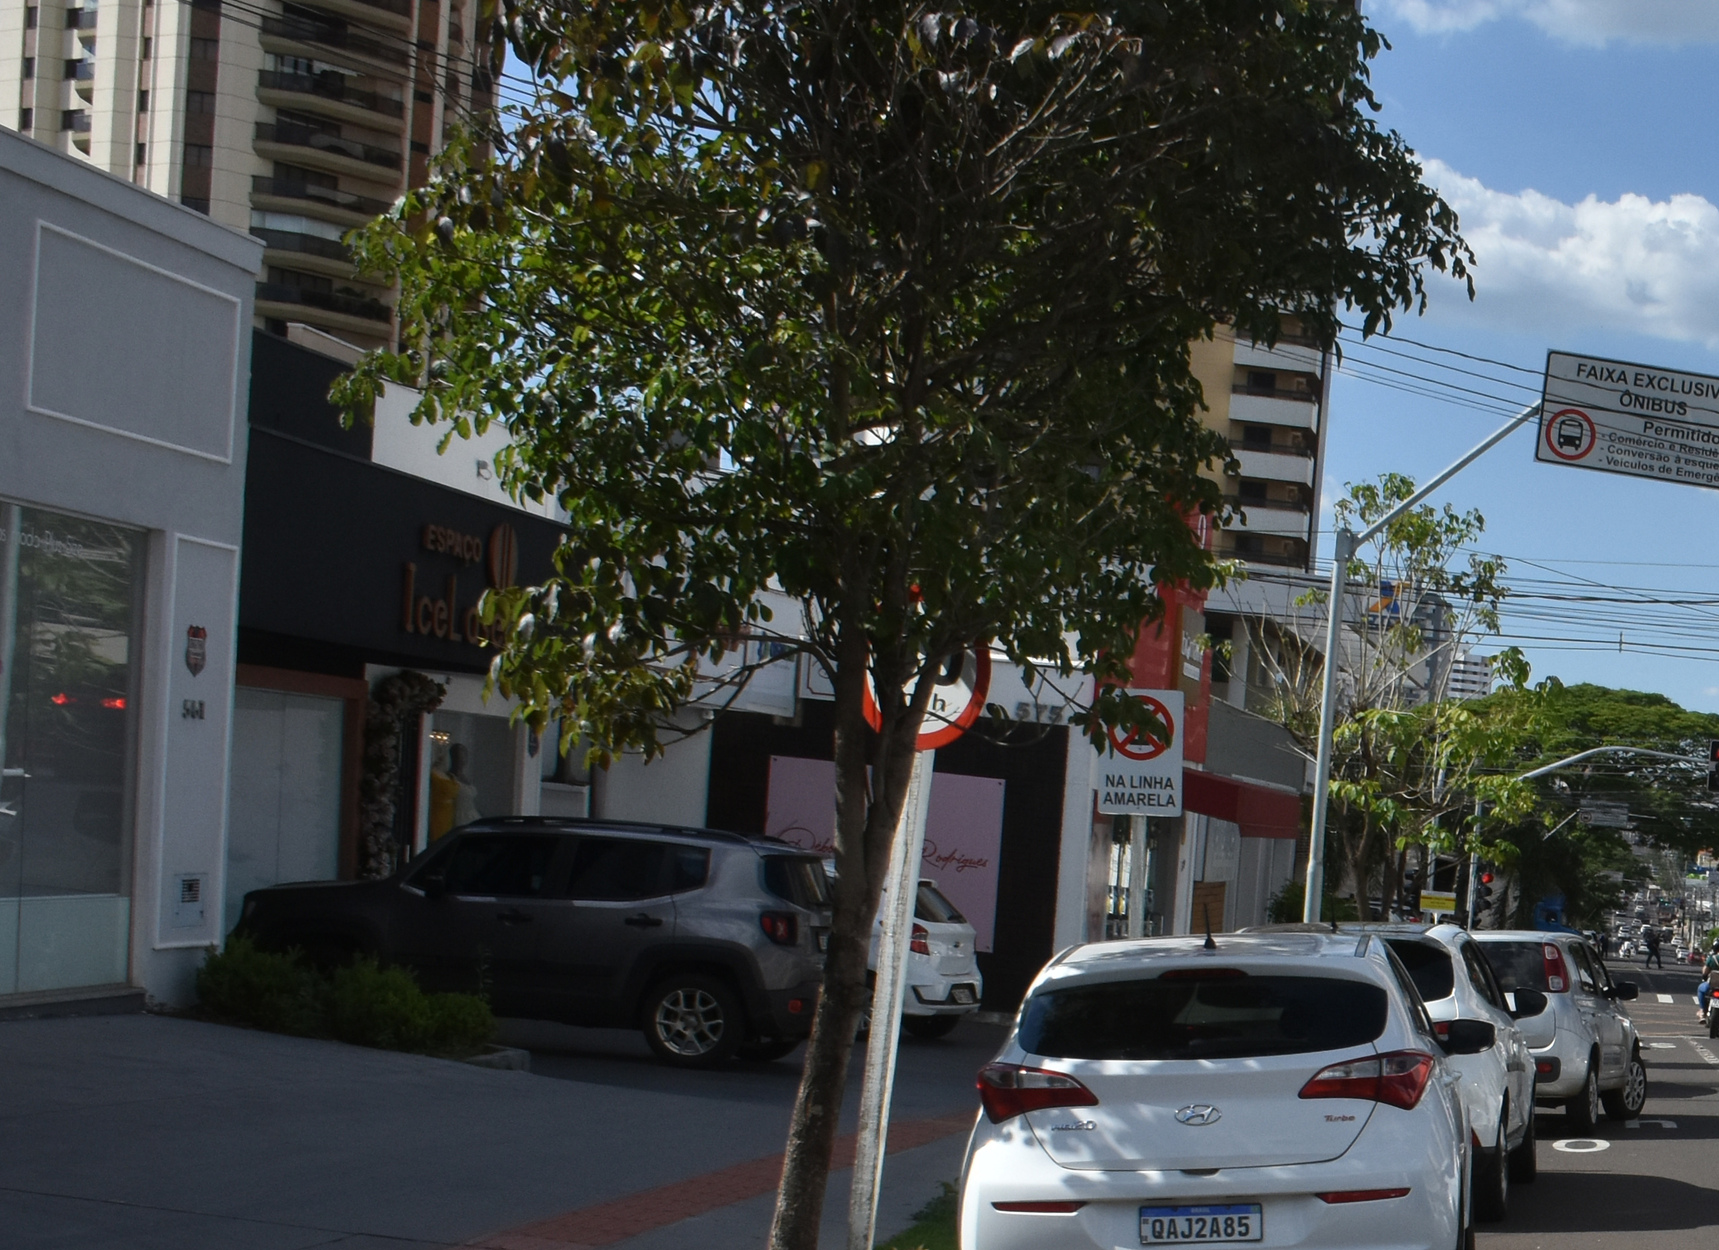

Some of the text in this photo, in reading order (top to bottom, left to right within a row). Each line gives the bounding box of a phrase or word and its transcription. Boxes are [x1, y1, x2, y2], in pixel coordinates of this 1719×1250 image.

[1577, 363, 1628, 385] FAIXA
[1619, 389, 1688, 416] ÔNIBUS
[1607, 445, 1670, 463] Conversão
[1658, 463, 1673, 475] de
[421, 523, 482, 567] ESPAÇO
[1105, 774, 1175, 791] NA LINHA
[1103, 791, 1177, 808] AMARELA
[1151, 1215, 1250, 1240] QAJ2A85
